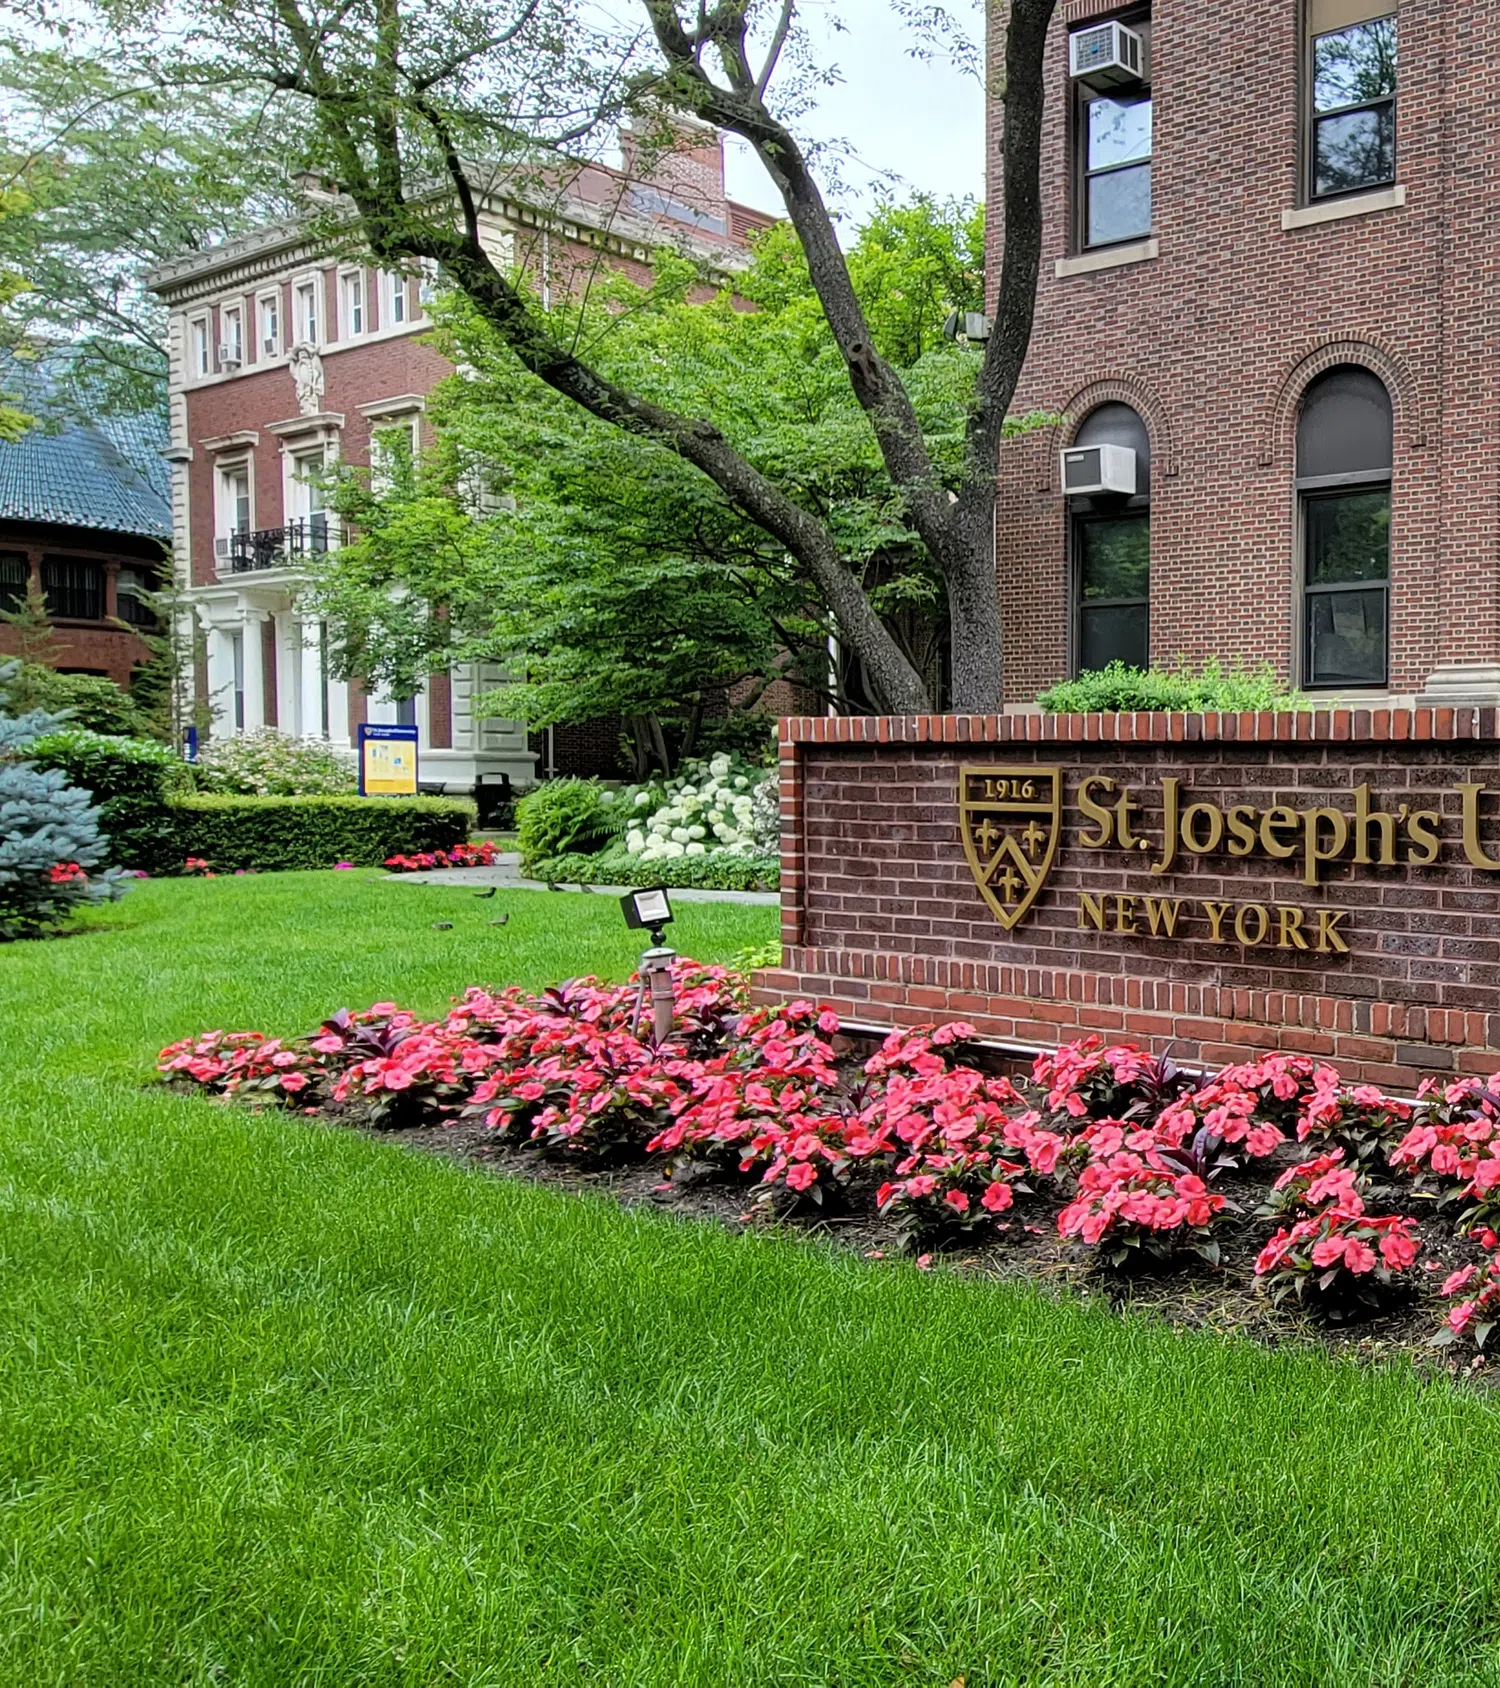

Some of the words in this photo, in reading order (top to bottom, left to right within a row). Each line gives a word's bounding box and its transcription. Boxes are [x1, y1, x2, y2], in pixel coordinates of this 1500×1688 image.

[984, 779, 1036, 799] 1916
[1077, 775, 1149, 850] St.
[1151, 777, 1442, 887] Joseph's
[1077, 892, 1186, 938] NEW
[1201, 901, 1350, 952] YORK
